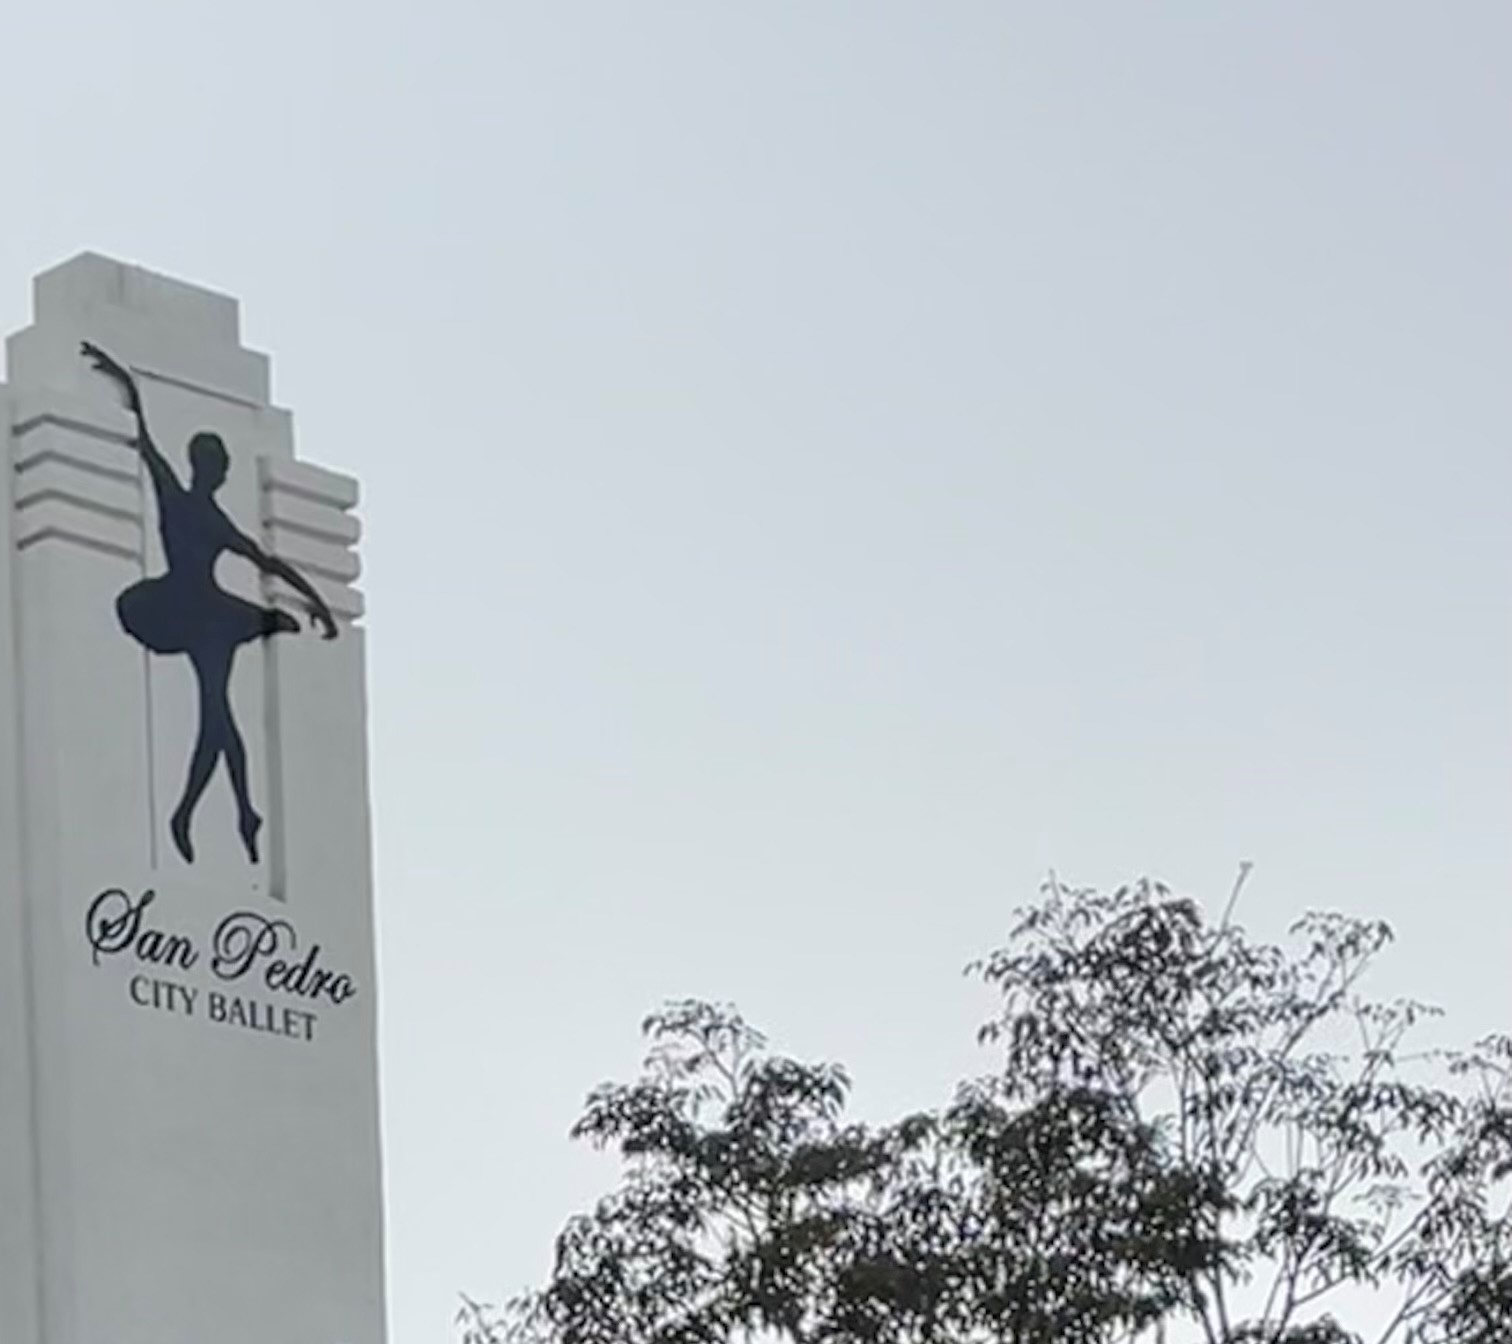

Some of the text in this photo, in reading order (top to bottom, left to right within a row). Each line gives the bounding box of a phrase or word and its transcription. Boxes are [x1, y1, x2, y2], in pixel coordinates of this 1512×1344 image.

[86, 888, 358, 1004] San Pedro
[129, 976, 317, 1042] CITY BALLET
